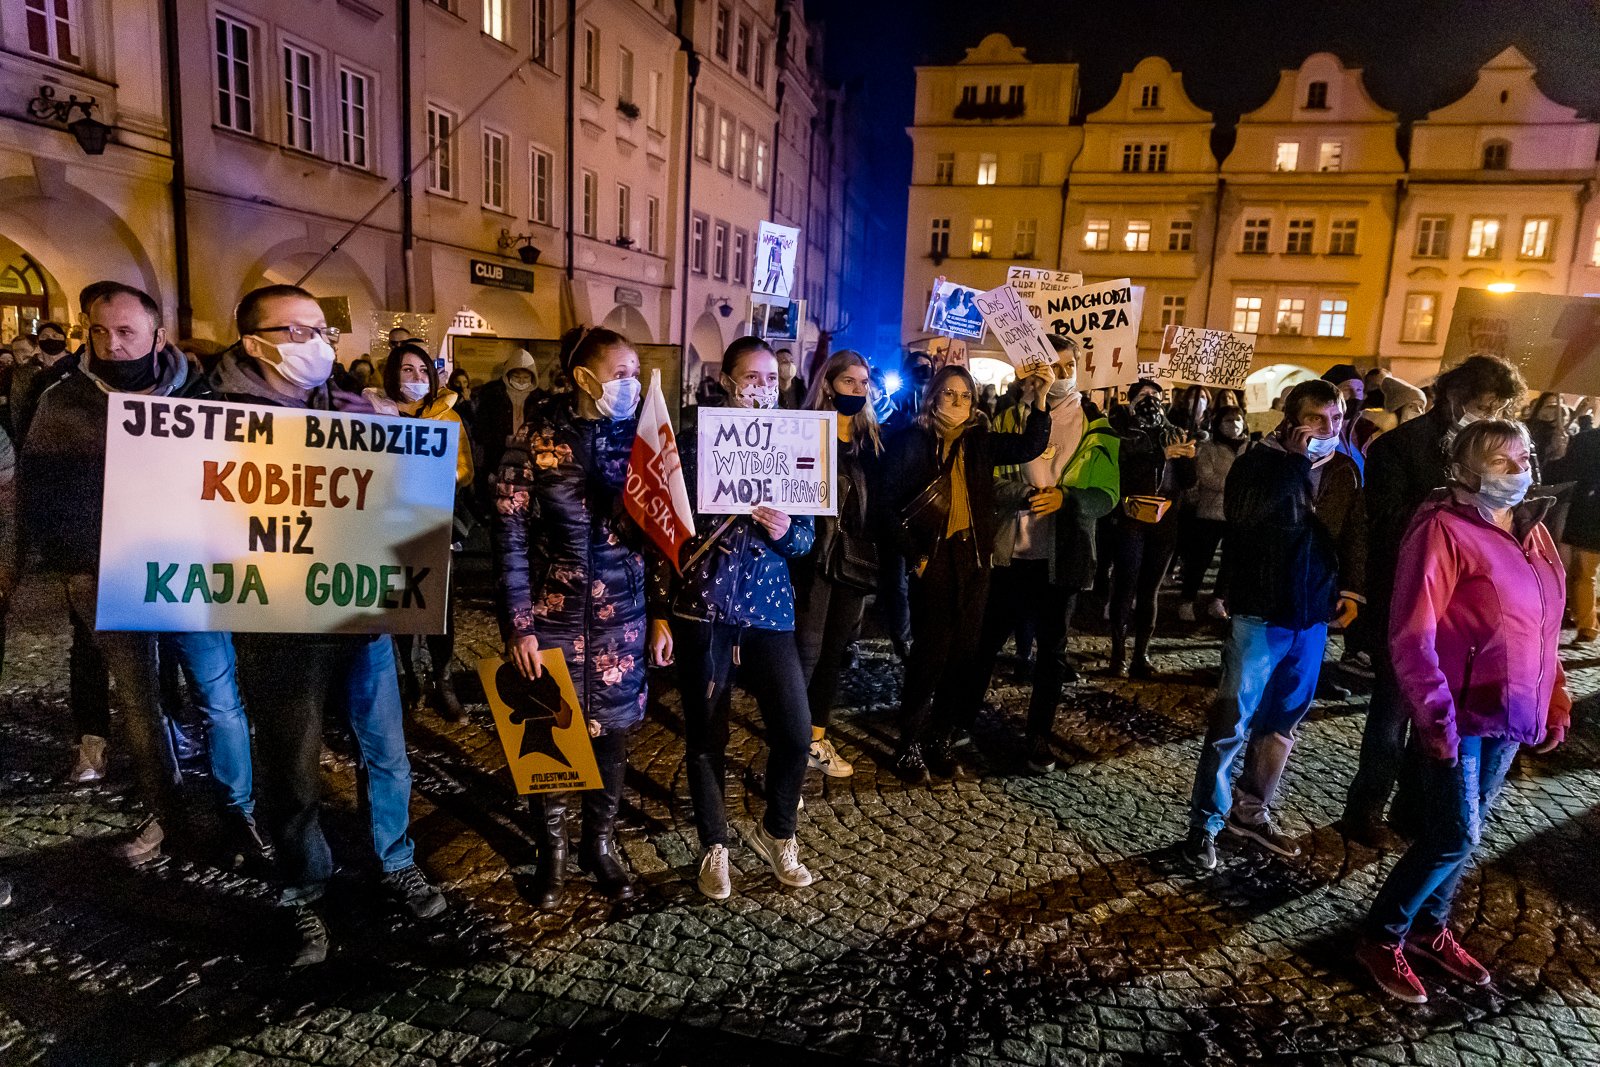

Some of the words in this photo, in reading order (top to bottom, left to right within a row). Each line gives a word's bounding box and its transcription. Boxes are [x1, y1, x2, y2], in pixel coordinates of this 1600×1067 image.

[475, 262, 503, 279] CLUB
[1010, 269, 1031, 279] ZA
[1036, 271, 1050, 281] TO
[1012, 280, 1036, 289] LUDZI
[1047, 287, 1132, 315] NADCHODZI
[1050, 308, 1129, 336] BURZA
[1182, 328, 1196, 337] TA
[1204, 330, 1236, 342] MAŁA
[1019, 340, 1032, 354] W
[1174, 353, 1218, 366] STANOWI
[1155, 368, 1178, 378] JEST
[122, 400, 274, 445] JESTEM
[714, 418, 773, 450] MÓJ
[712, 446, 790, 476] WYBÓR
[712, 478, 773, 506] MOJE
[781, 478, 828, 504] PRAWO
[626, 464, 675, 545] POLSKA
[144, 561, 269, 605] KAJA
[304, 562, 431, 610] GODEK
[531, 770, 580, 783] #TOJESTWOJNA
